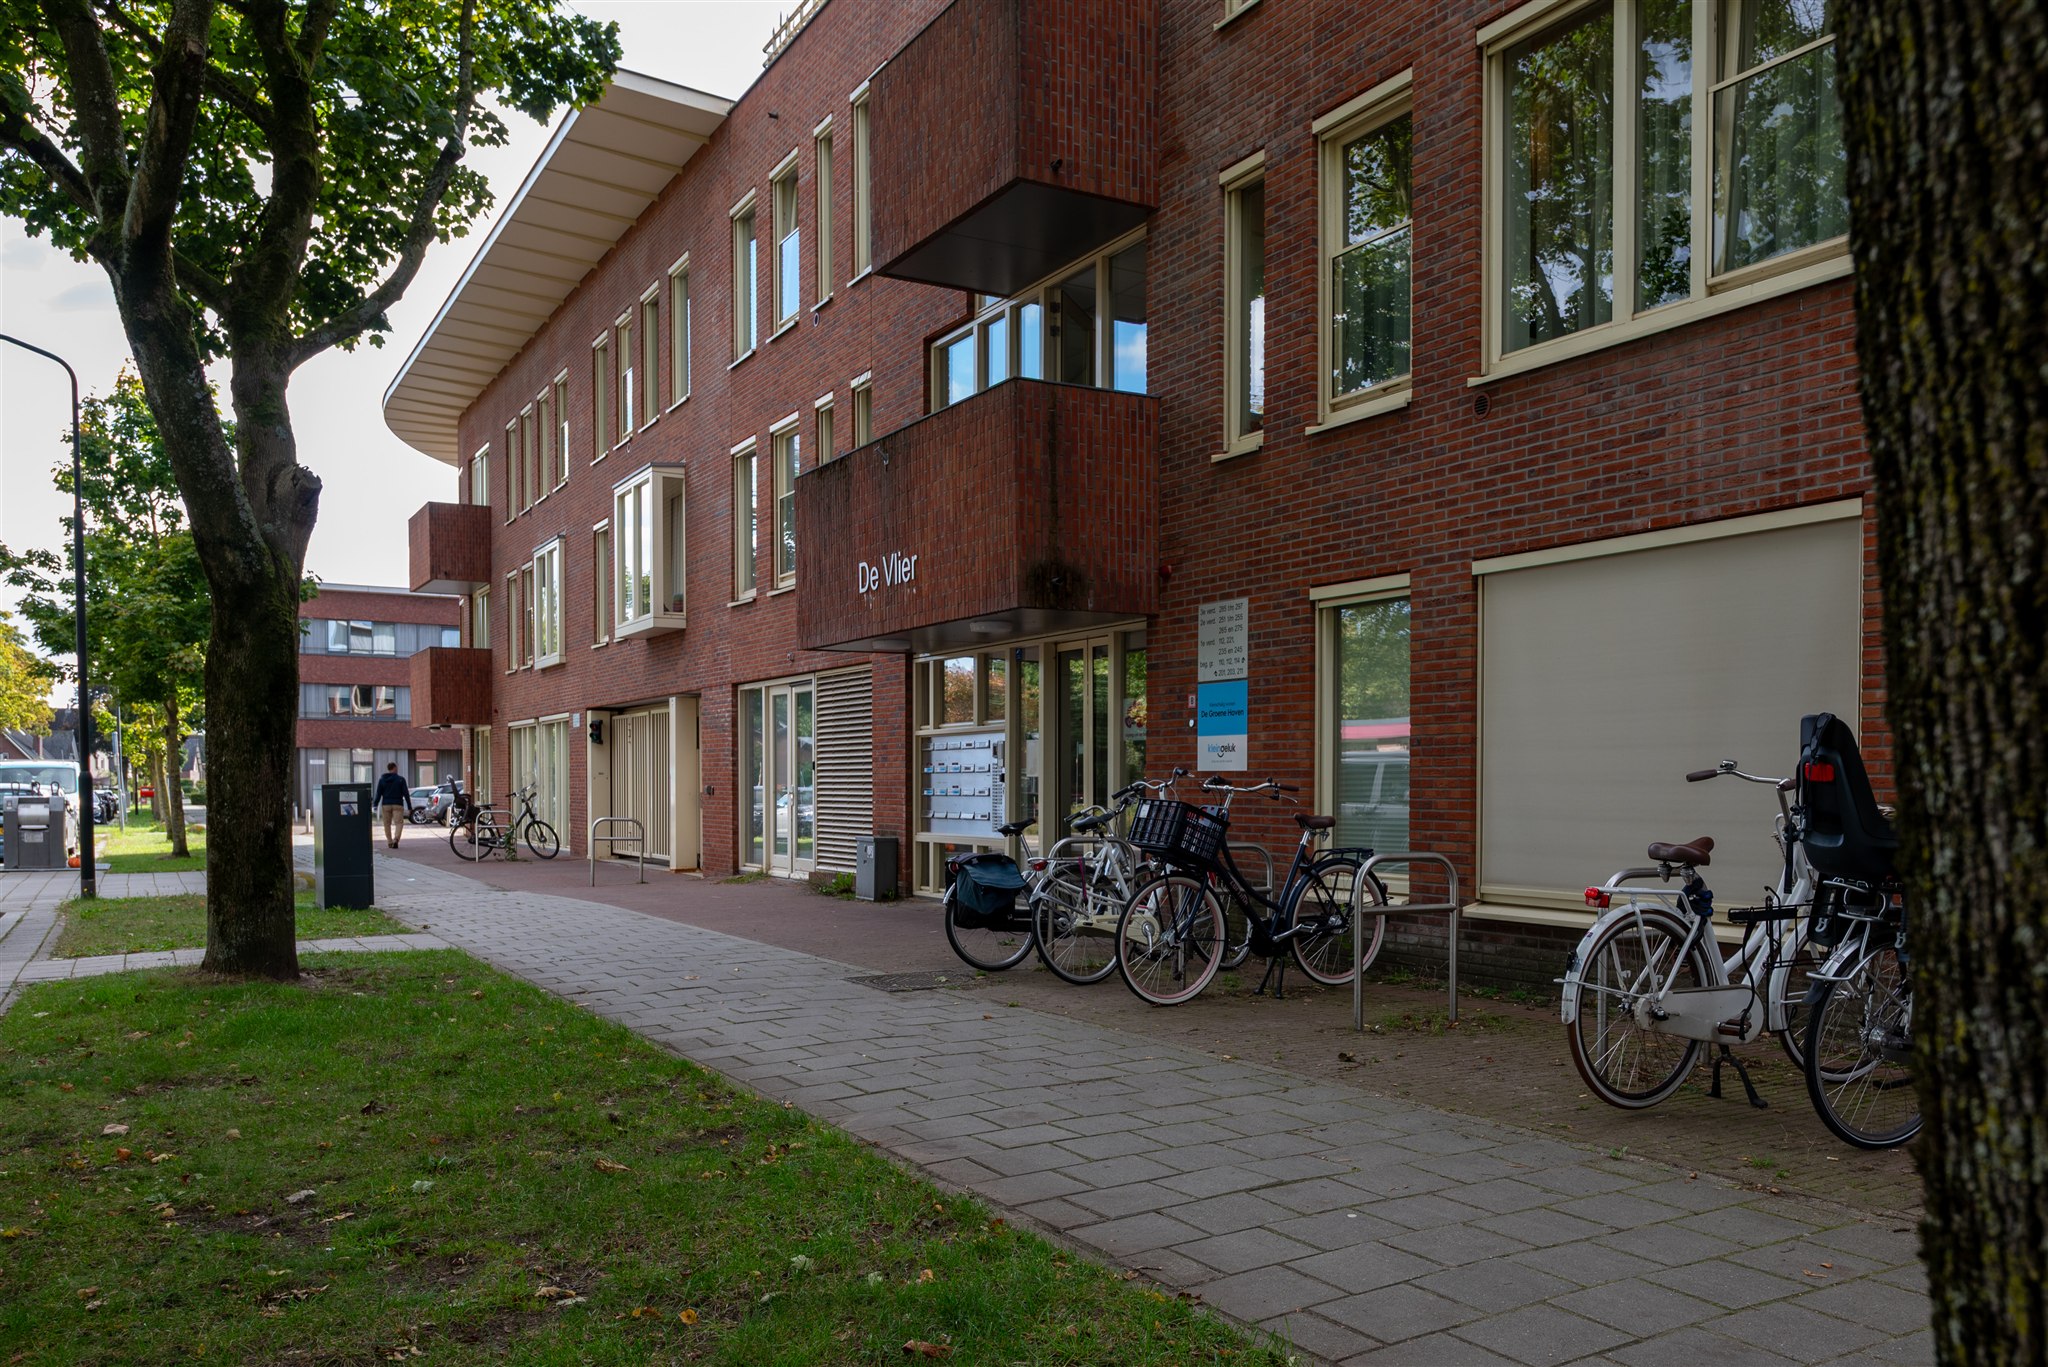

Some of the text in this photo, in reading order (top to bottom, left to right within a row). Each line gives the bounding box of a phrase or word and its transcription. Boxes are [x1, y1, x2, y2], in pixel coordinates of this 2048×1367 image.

[858, 551, 918, 594] De Vlier
[1218, 648, 1227, 656] 235
[1234, 646, 1243, 654] 245
[1201, 708, 1244, 718] De Groene Hoven
